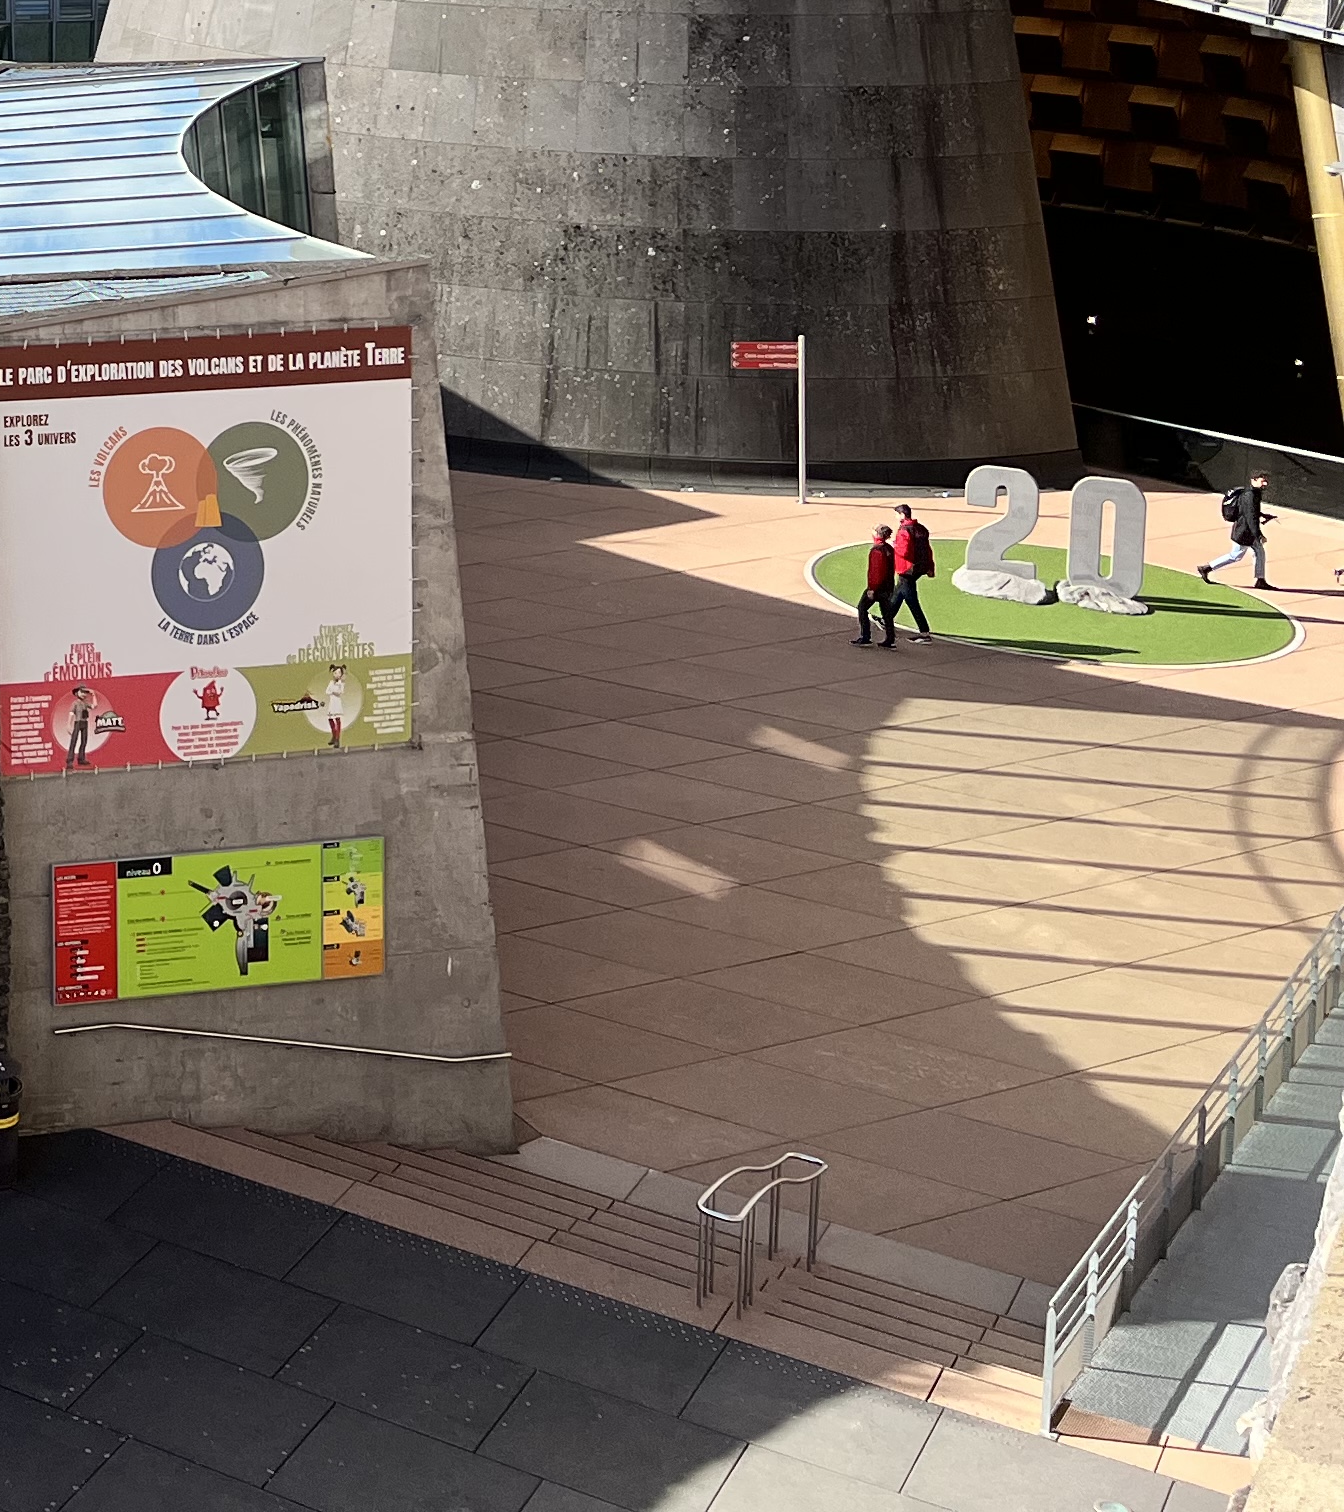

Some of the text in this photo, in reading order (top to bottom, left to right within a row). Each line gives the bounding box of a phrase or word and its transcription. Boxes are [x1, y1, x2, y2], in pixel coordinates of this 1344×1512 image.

[18, 366, 53, 385] PARC
[57, 359, 154, 383] D'EXPLORATION
[159, 358, 184, 378] DES
[187, 355, 245, 376] VOLCANS
[248, 355, 264, 373] ET
[267, 354, 284, 372] DE
[288, 352, 304, 371] LA
[308, 346, 361, 370] PLANÈTE
[3, 414, 49, 428] EXPLOREZ
[3, 429, 77, 447] LES 3 UNIVERS
[88, 425, 128, 488] LES VOLCANS
[270, 408, 323, 532] LES PHÉNOMÈNES NATURELS
[965, 464, 1147, 599] 20
[157, 611, 260, 645] LA TERRE DANS L'ESPACE
[70, 642, 95, 654] FAITES
[298, 642, 375, 663] DÉCOUVERTES
[64, 651, 102, 665] LE PLEIN
[96, 716, 124, 727] MATT
[126, 862, 162, 877] niveau 0
